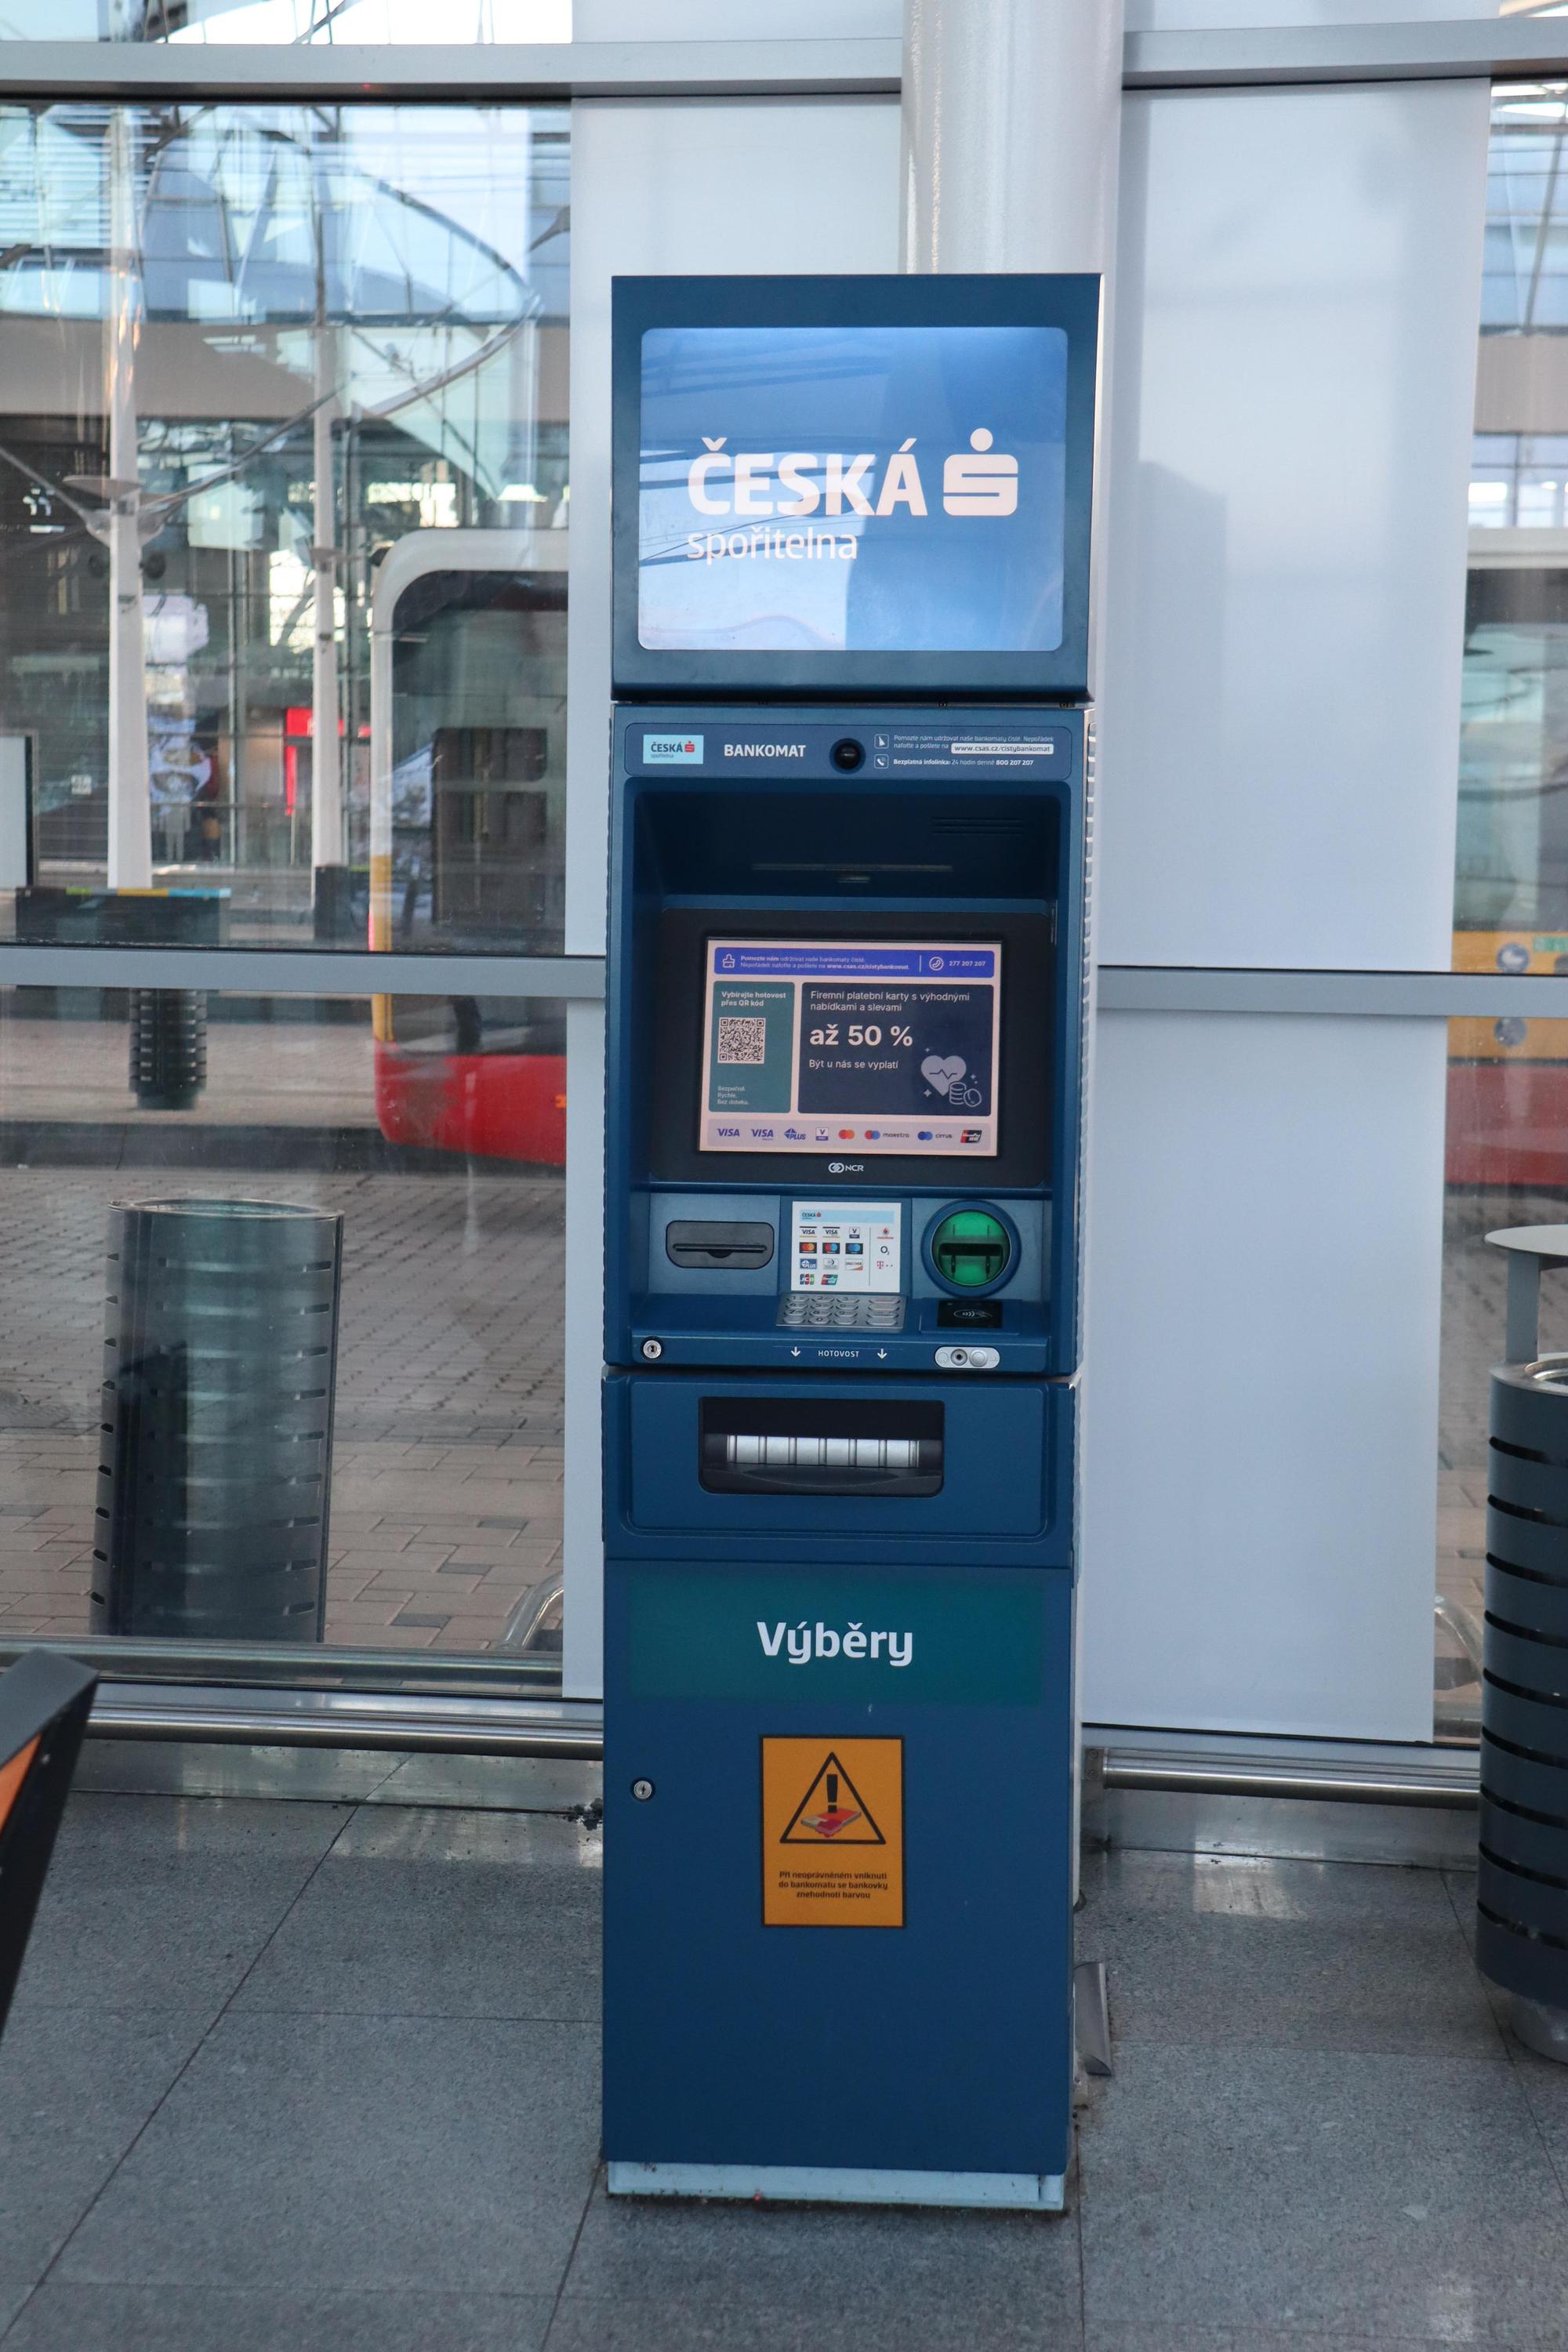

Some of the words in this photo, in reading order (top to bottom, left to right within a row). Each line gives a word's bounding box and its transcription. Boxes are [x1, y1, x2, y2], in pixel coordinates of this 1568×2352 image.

[687, 437, 928, 517] ČESKÁ
[686, 526, 858, 564] spořitelna
[651, 742, 683, 753] ČESKÁ
[724, 744, 806, 757] BANKOMAT
[954, 745, 1051, 753] www.csas.cz/cistybankomat
[721, 990, 753, 1000] Vybírejte
[810, 990, 845, 1000] Firemní
[847, 991, 884, 1002] platební
[885, 991, 909, 1002] karty
[920, 992, 970, 1003] výhodnými
[720, 999, 738, 1007] přes
[810, 1002, 857, 1011] nabídkami
[867, 1003, 902, 1012] slevami
[809, 1023, 840, 1046] až
[848, 1025, 882, 1047] 50
[890, 1025, 913, 1047] %
[809, 1059, 825, 1069] Být
[835, 1059, 852, 1069] nás
[867, 1060, 898, 1071] vyplatí
[717, 1128, 740, 1137] VISA
[751, 1129, 774, 1138] VISA
[757, 1621, 913, 1667] Výběry
[792, 1871, 852, 1879] neoprávněném
[854, 1871, 887, 1880] vniknutí
[848, 1882, 888, 1890] bankovky
